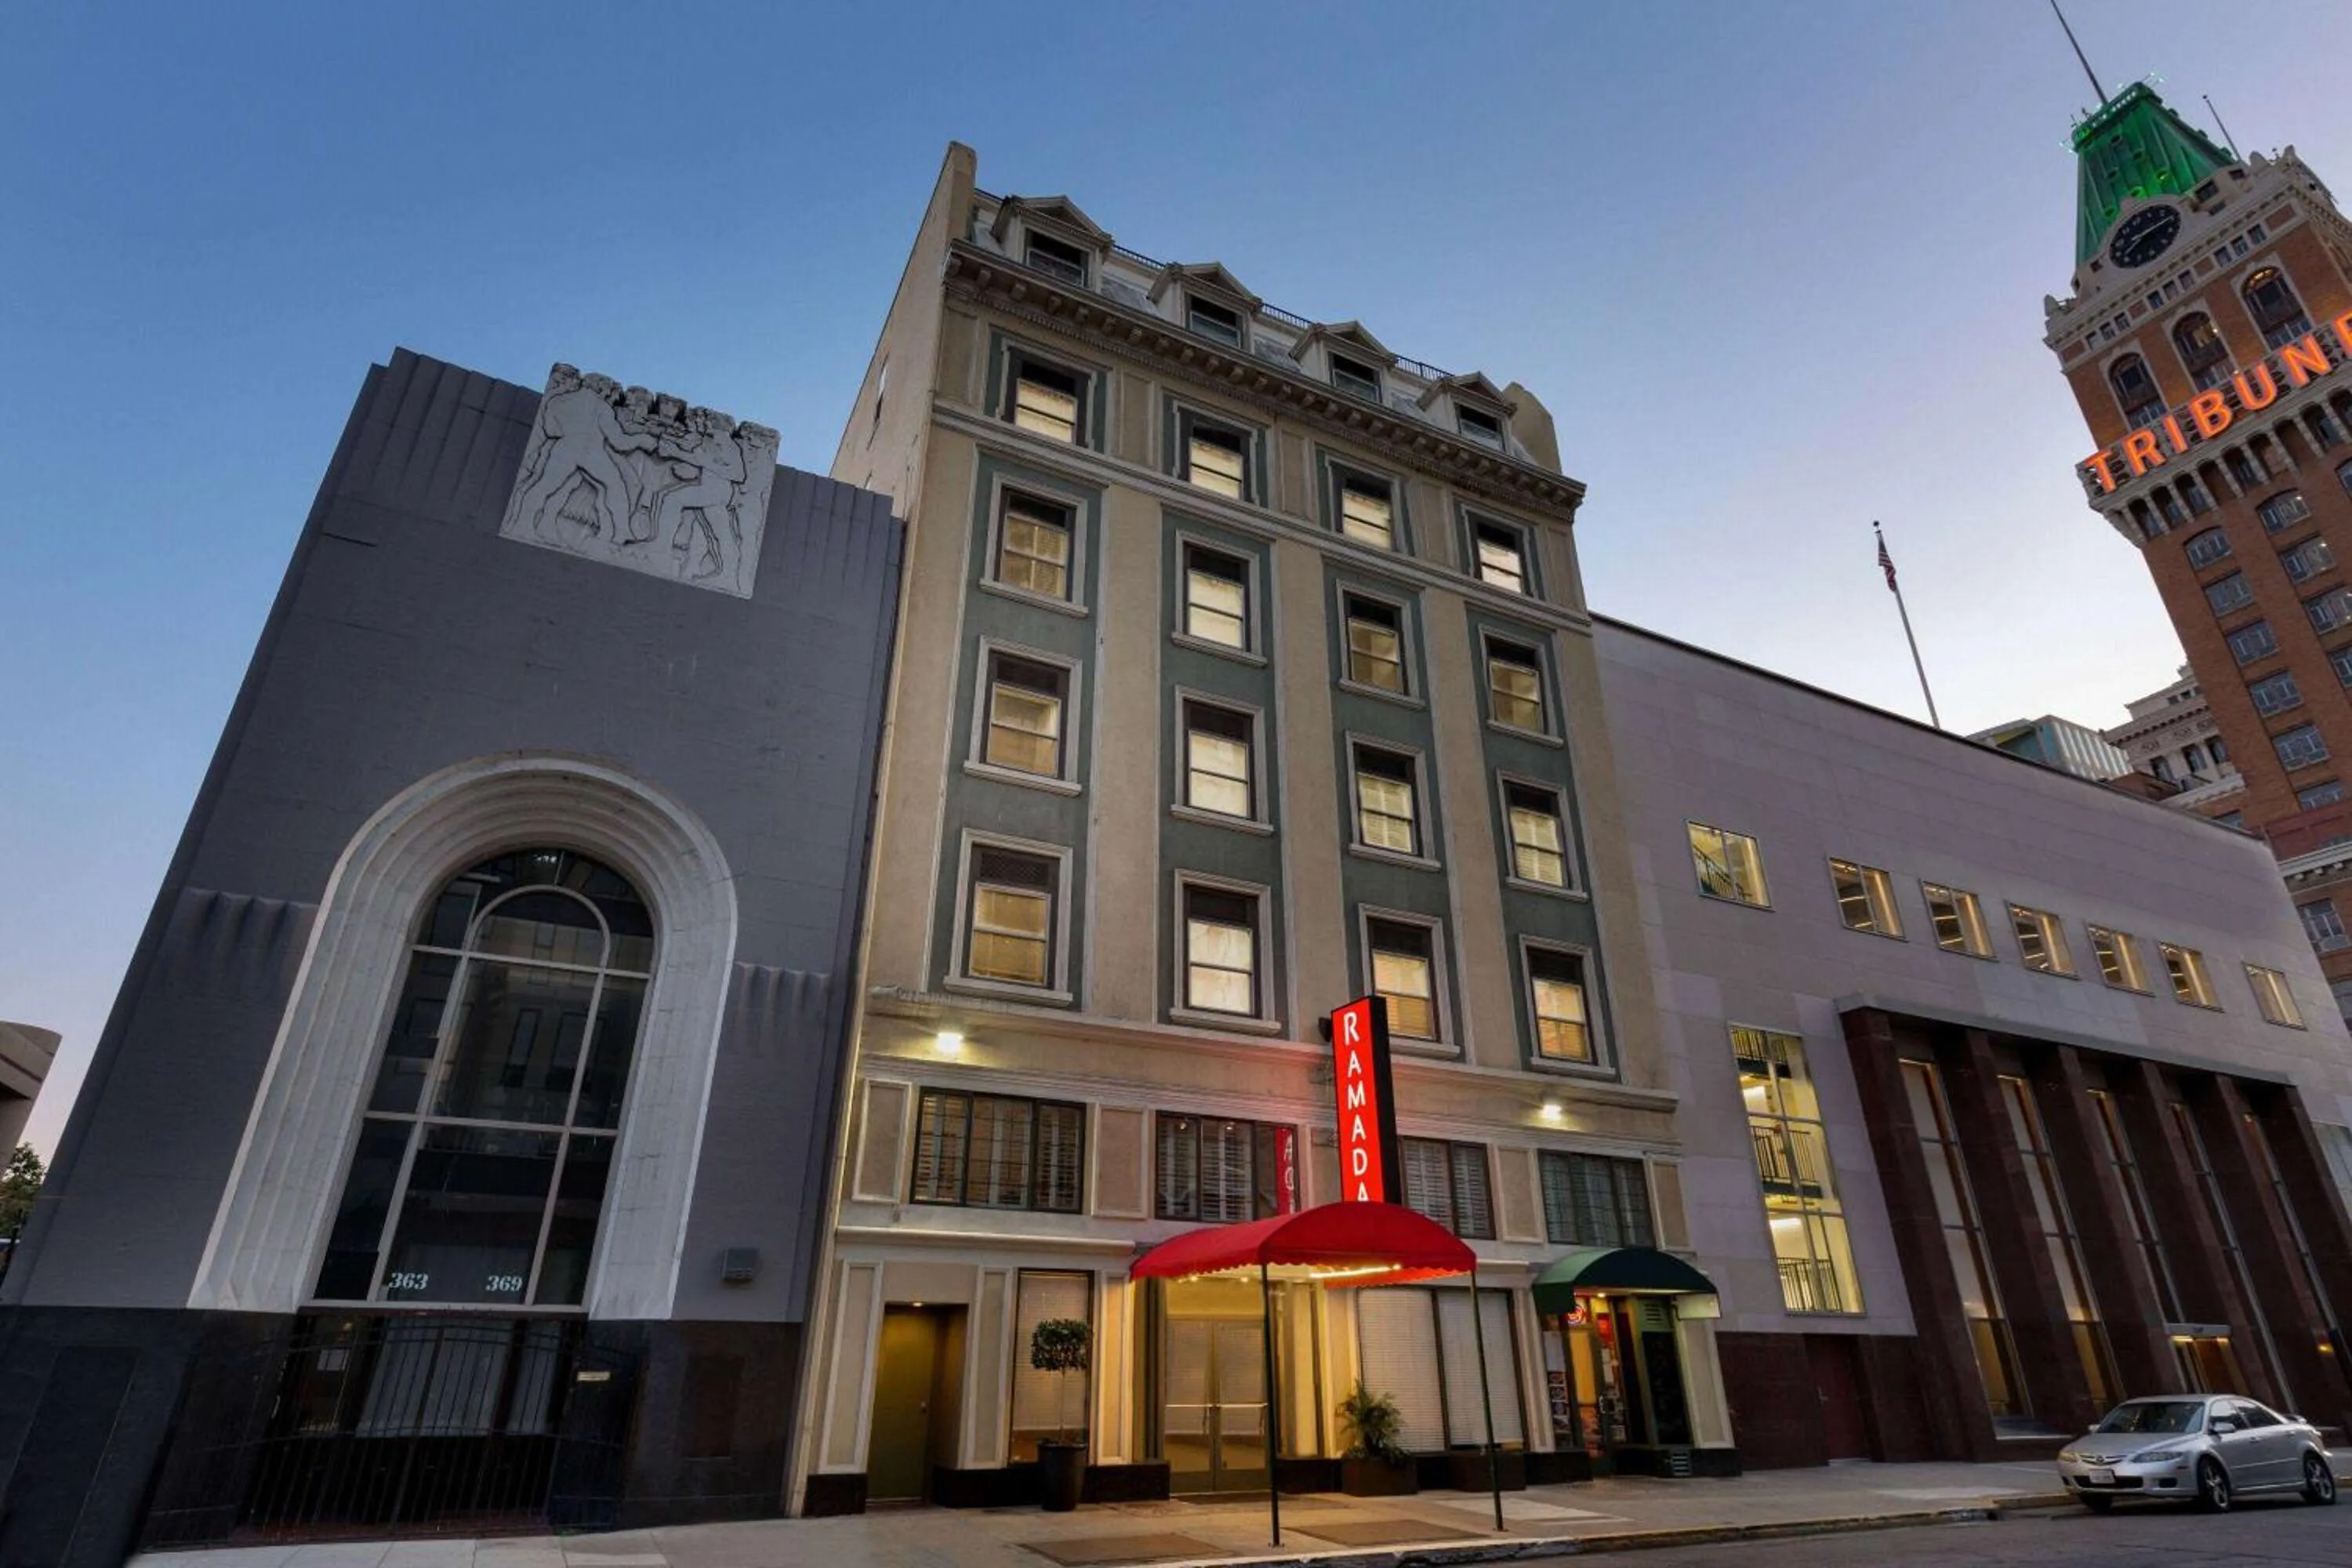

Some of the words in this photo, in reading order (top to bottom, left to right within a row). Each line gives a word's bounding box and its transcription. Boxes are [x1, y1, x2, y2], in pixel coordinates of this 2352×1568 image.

[1343, 1011, 1370, 1202] RAMADA
[388, 1272, 429, 1290] 363
[485, 1274, 523, 1292] 369
